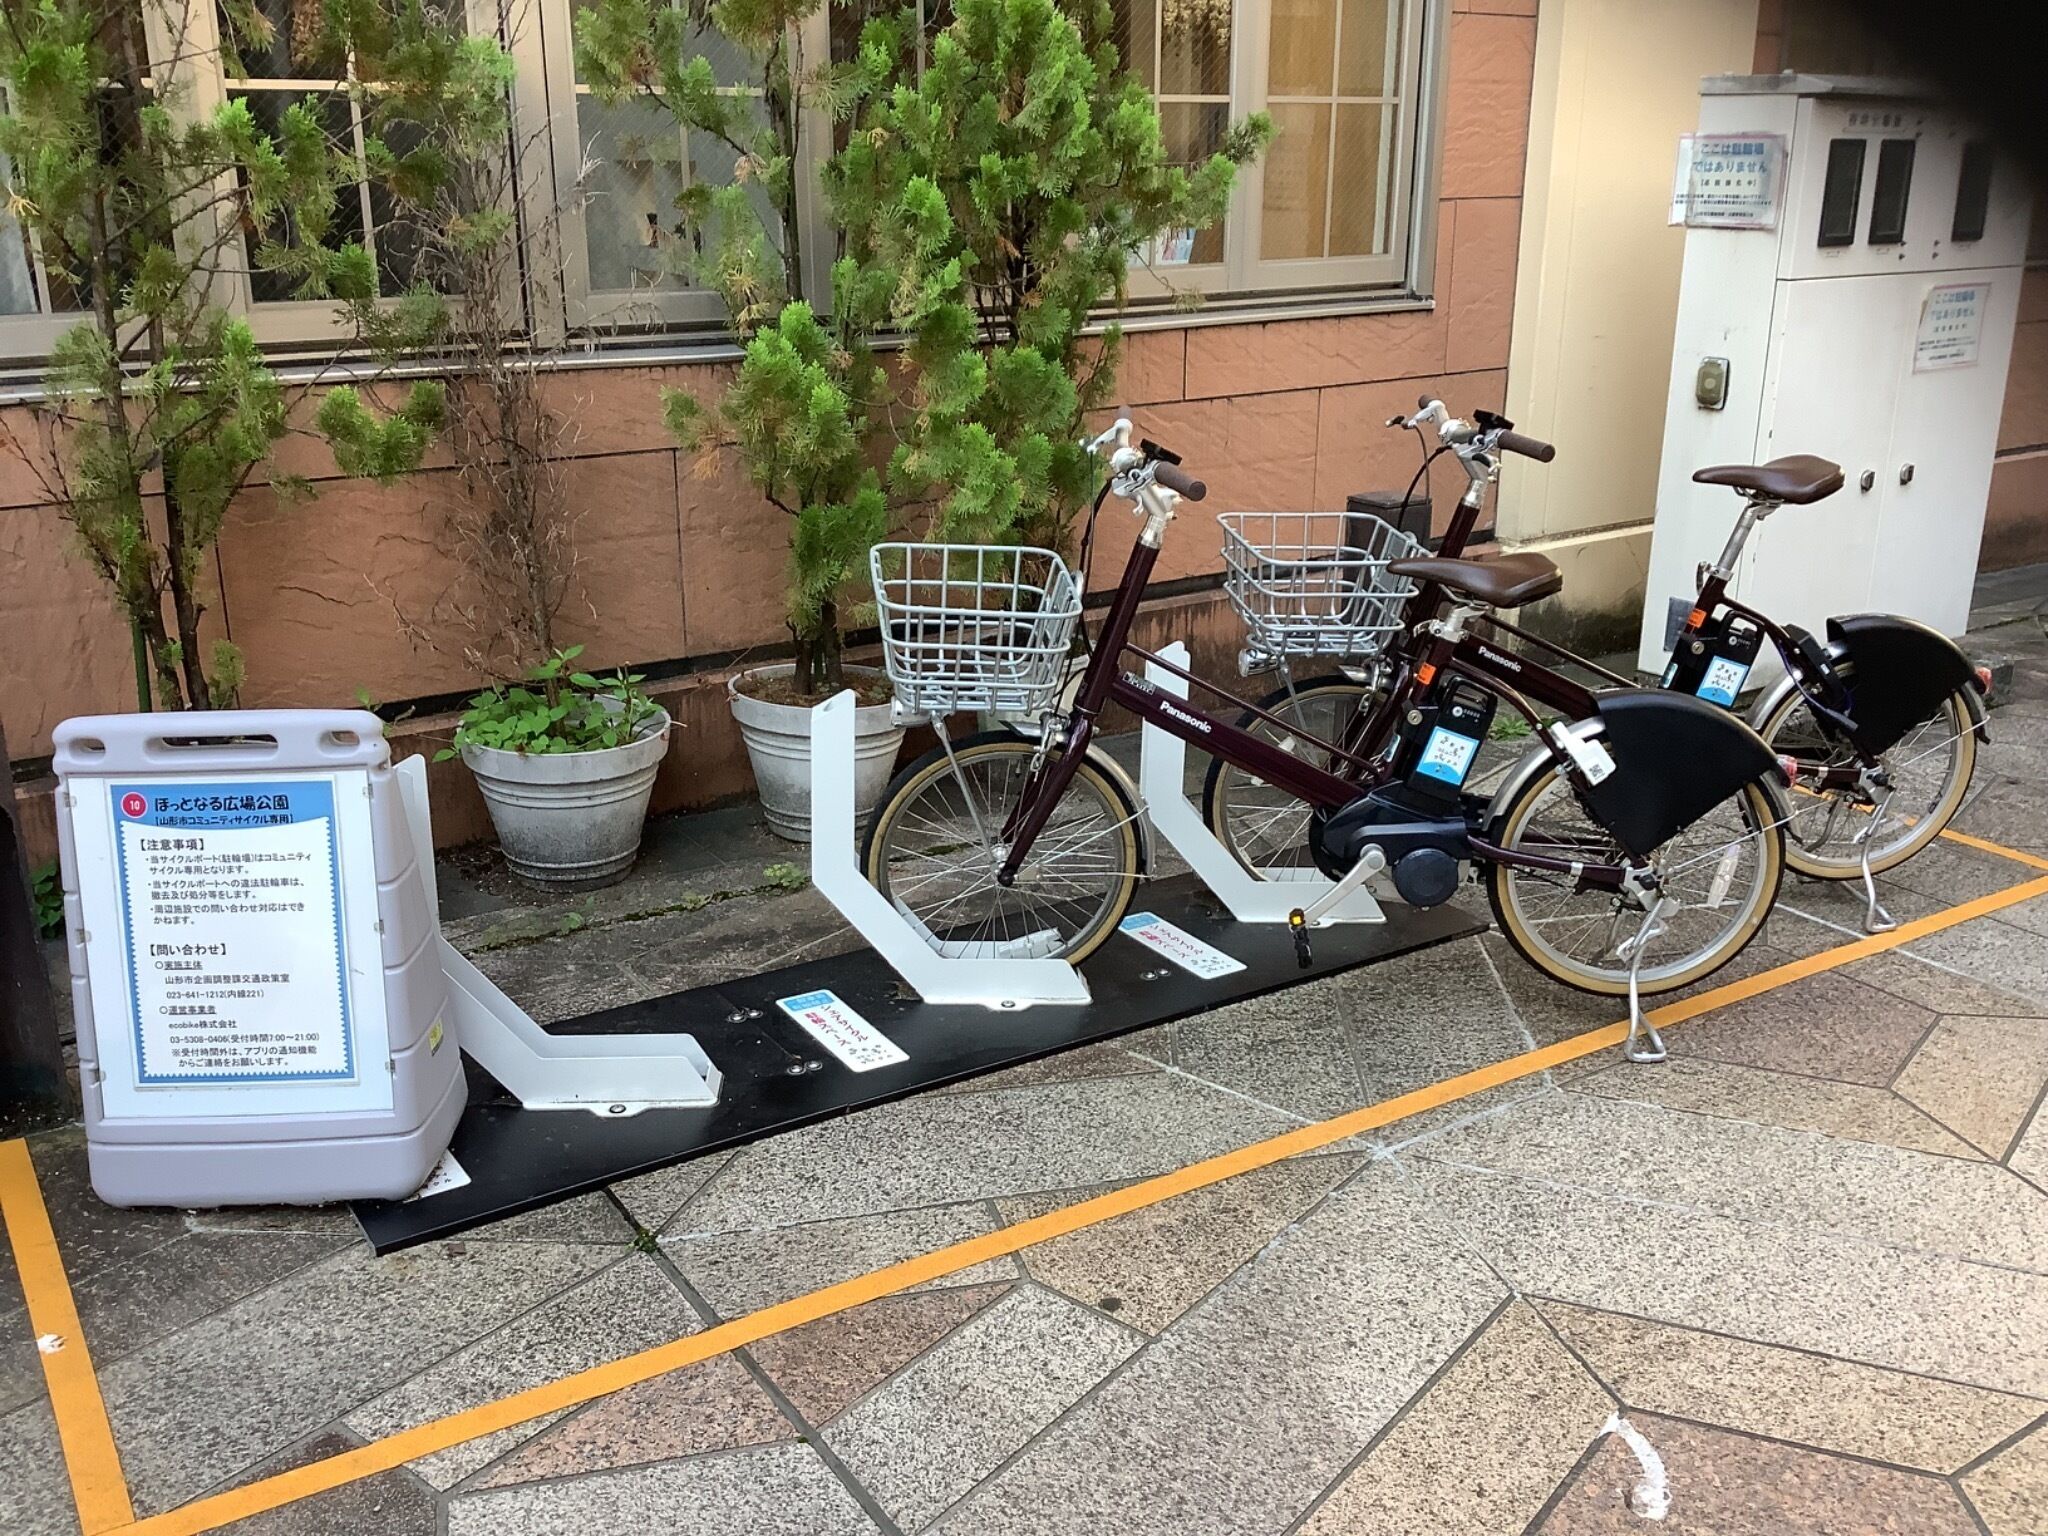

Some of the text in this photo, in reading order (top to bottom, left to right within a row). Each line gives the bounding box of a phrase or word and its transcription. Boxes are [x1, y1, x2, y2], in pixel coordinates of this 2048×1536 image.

[1478, 646, 1522, 672] Panasonic
[1160, 700, 1212, 734] Panasonic
[129, 800, 140, 811] 10
[155, 795, 289, 812] ほっとなる広場公園
[149, 943, 227, 957] 【問い合わせ】
